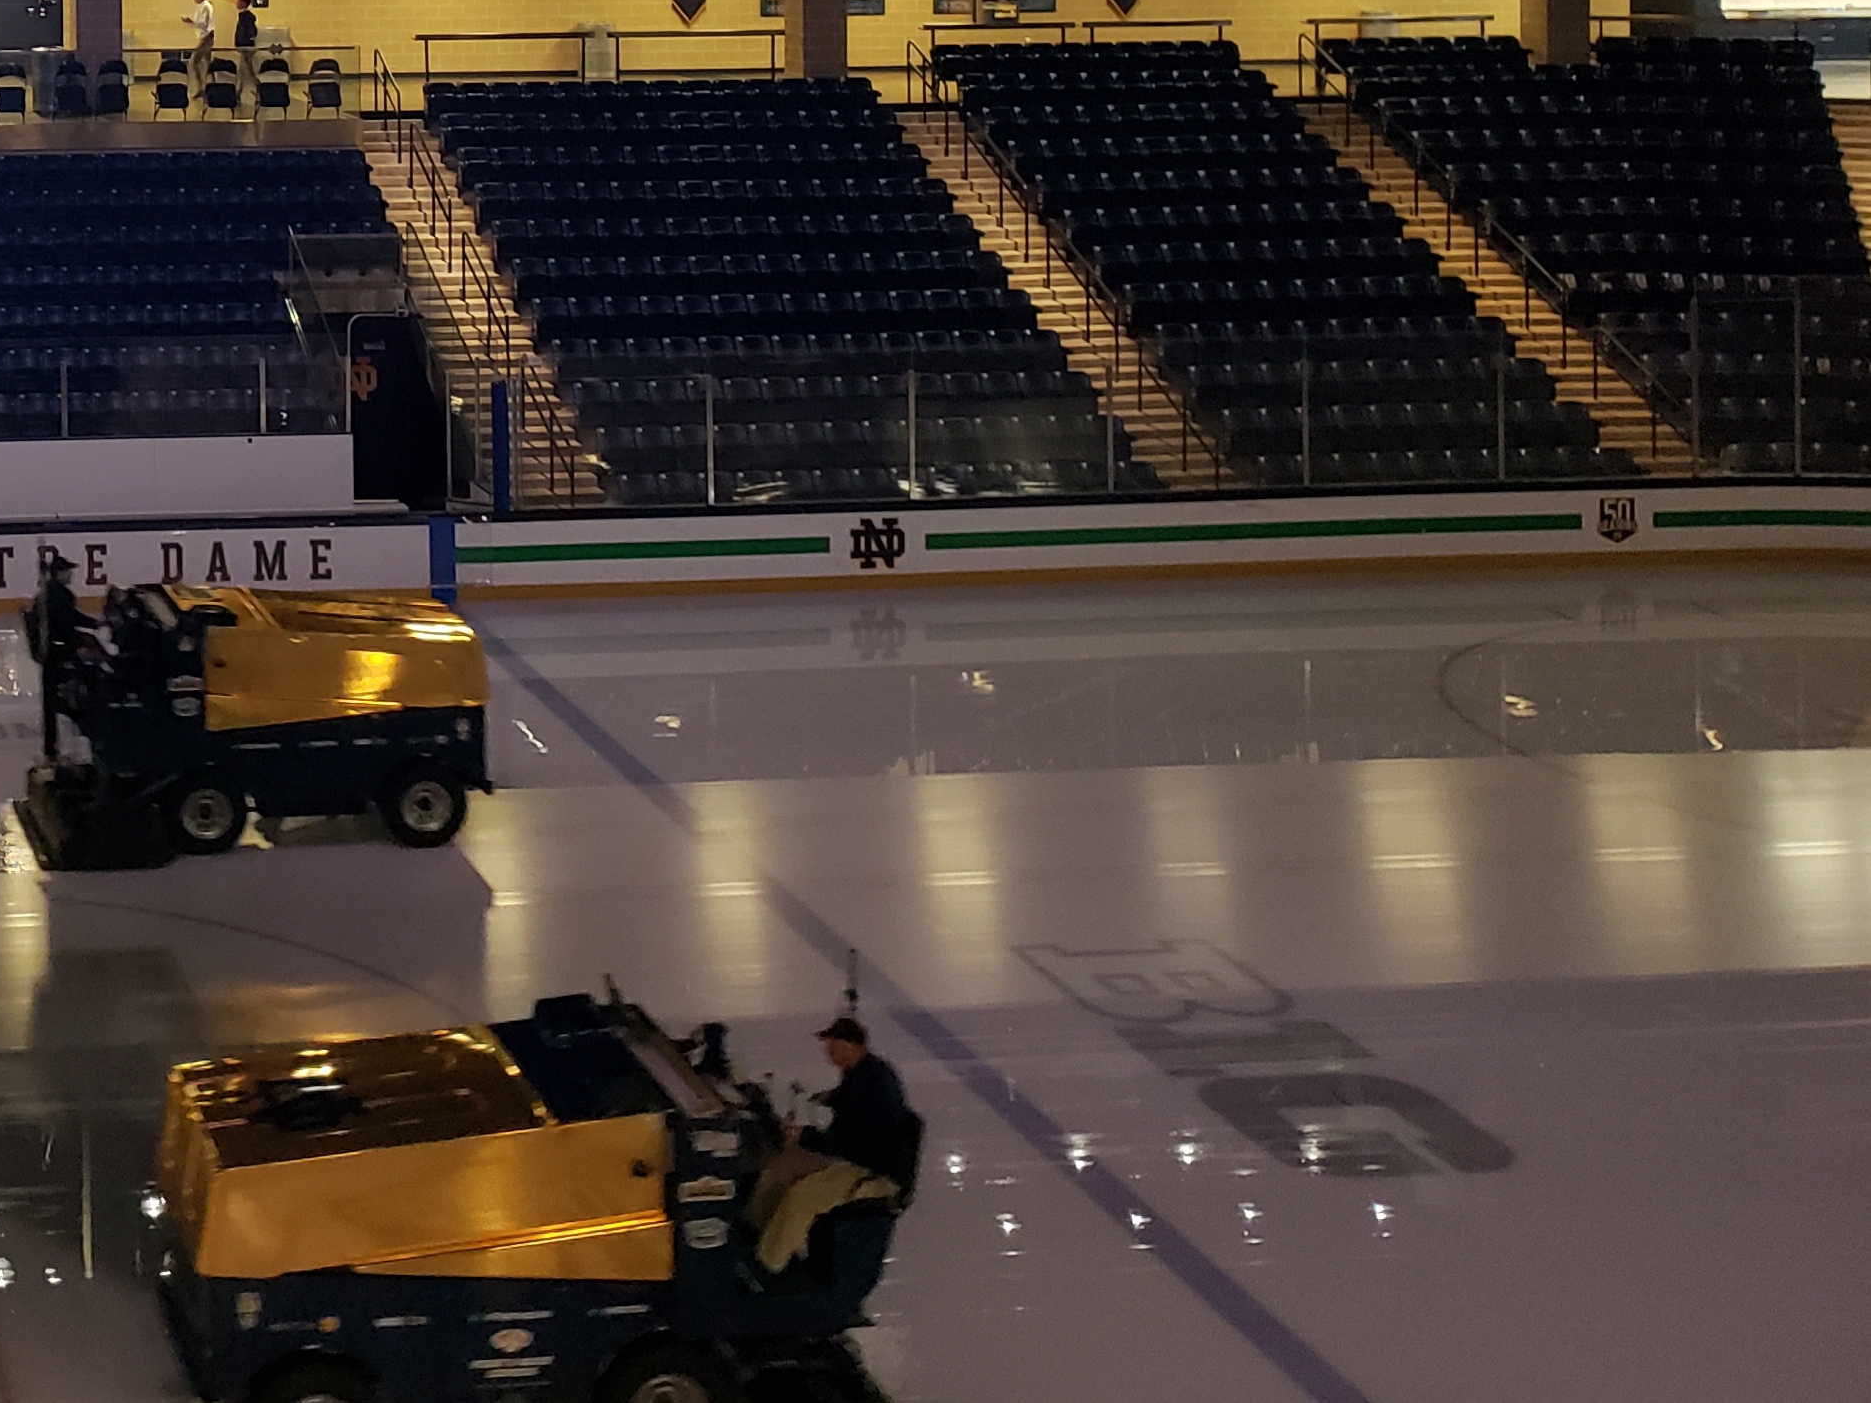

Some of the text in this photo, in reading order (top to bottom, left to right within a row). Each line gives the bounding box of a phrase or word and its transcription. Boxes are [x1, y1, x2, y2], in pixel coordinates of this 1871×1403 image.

[1603, 498, 1632, 520] 50
[160, 539, 333, 585] DAME
[850, 517, 905, 569] ND
